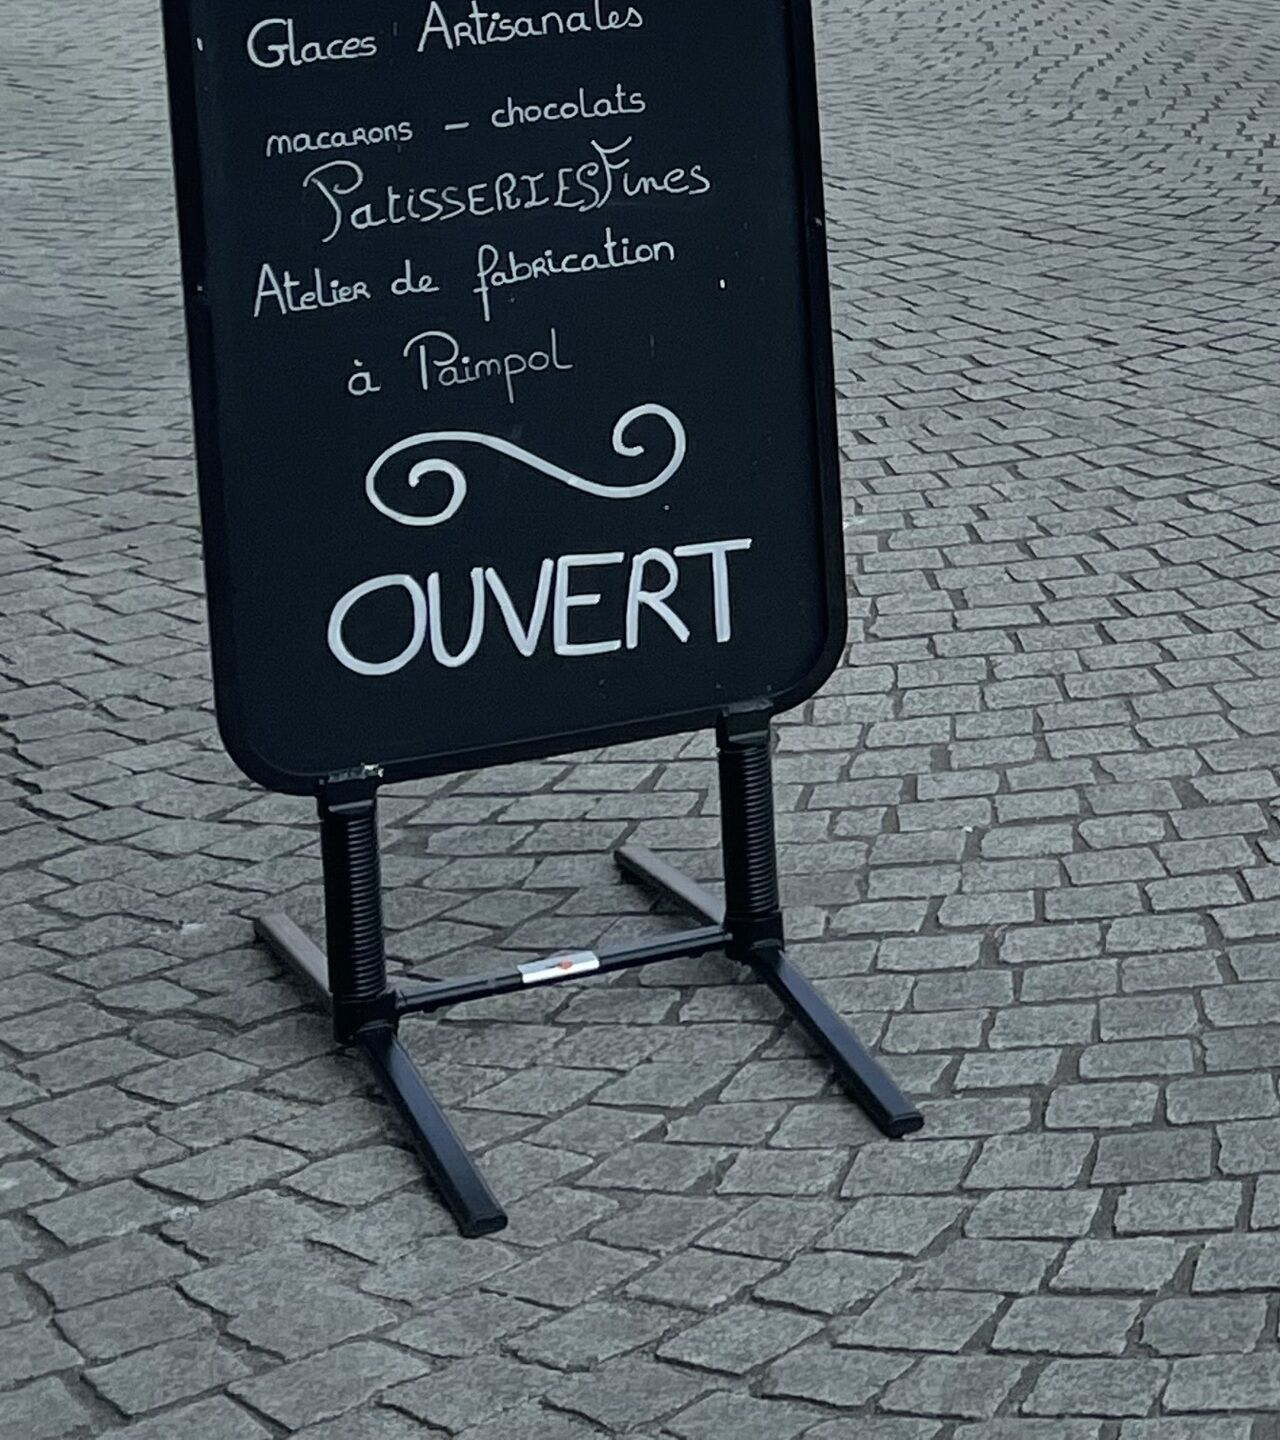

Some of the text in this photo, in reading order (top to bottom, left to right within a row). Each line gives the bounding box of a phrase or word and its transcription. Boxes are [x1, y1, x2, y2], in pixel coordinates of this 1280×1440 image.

[246, 18, 378, 69] Glaces
[491, 83, 646, 128] chocolats
[390, 259, 440, 296] de
[347, 327, 574, 404] à Paimpol
[327, 537, 753, 676] OUVERT
